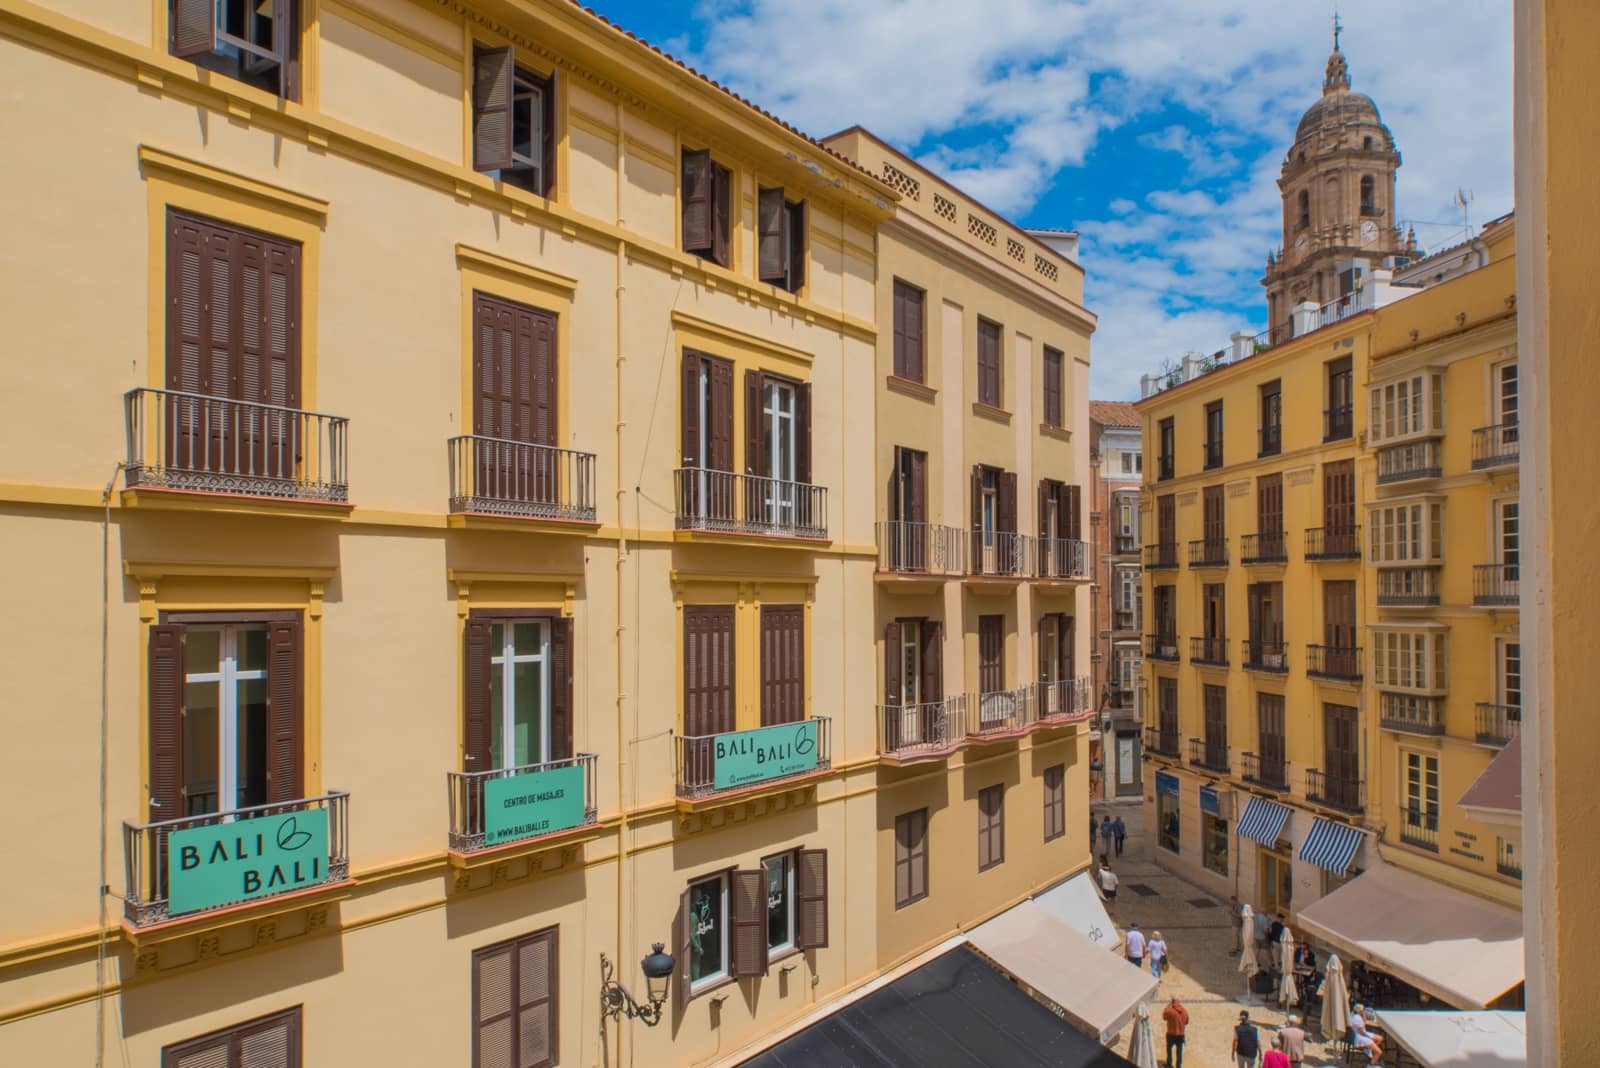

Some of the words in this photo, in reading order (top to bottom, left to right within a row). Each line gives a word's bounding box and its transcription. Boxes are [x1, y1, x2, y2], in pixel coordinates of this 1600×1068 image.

[717, 737, 754, 759] BALI
[756, 743, 791, 764] BALI
[503, 796, 528, 808] CENTRO
[528, 794, 536, 804] DE
[537, 789, 564, 801] MASAJES
[180, 833, 263, 871] BALI
[244, 857, 319, 894] BALI
